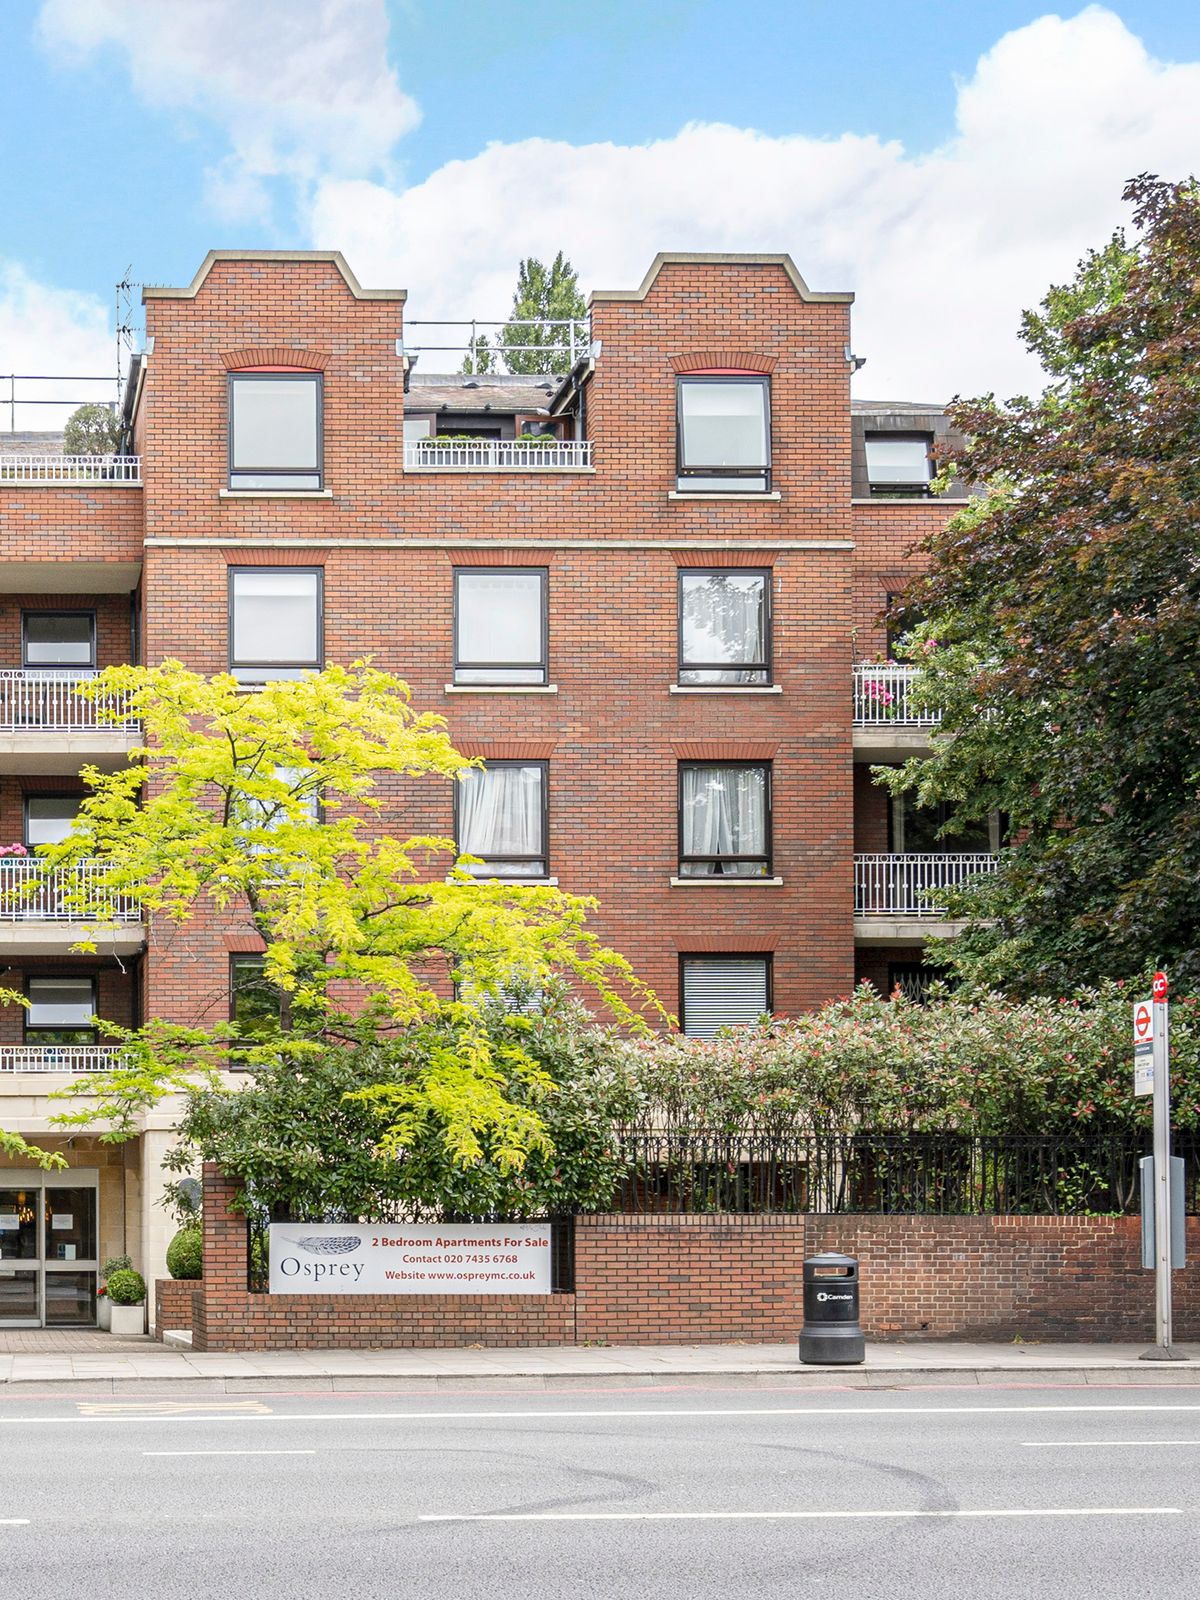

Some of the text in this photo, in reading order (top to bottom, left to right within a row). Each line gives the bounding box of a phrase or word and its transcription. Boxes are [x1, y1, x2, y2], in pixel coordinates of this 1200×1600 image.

[372, 1237, 549, 1249] 2 Bedroom Apartments For Sale
[402, 1254, 518, 1263] Contact 020 7435 6768
[280, 1257, 365, 1281] Osprey
[385, 1270, 536, 1282] Website www.ospreymc.co.uk
